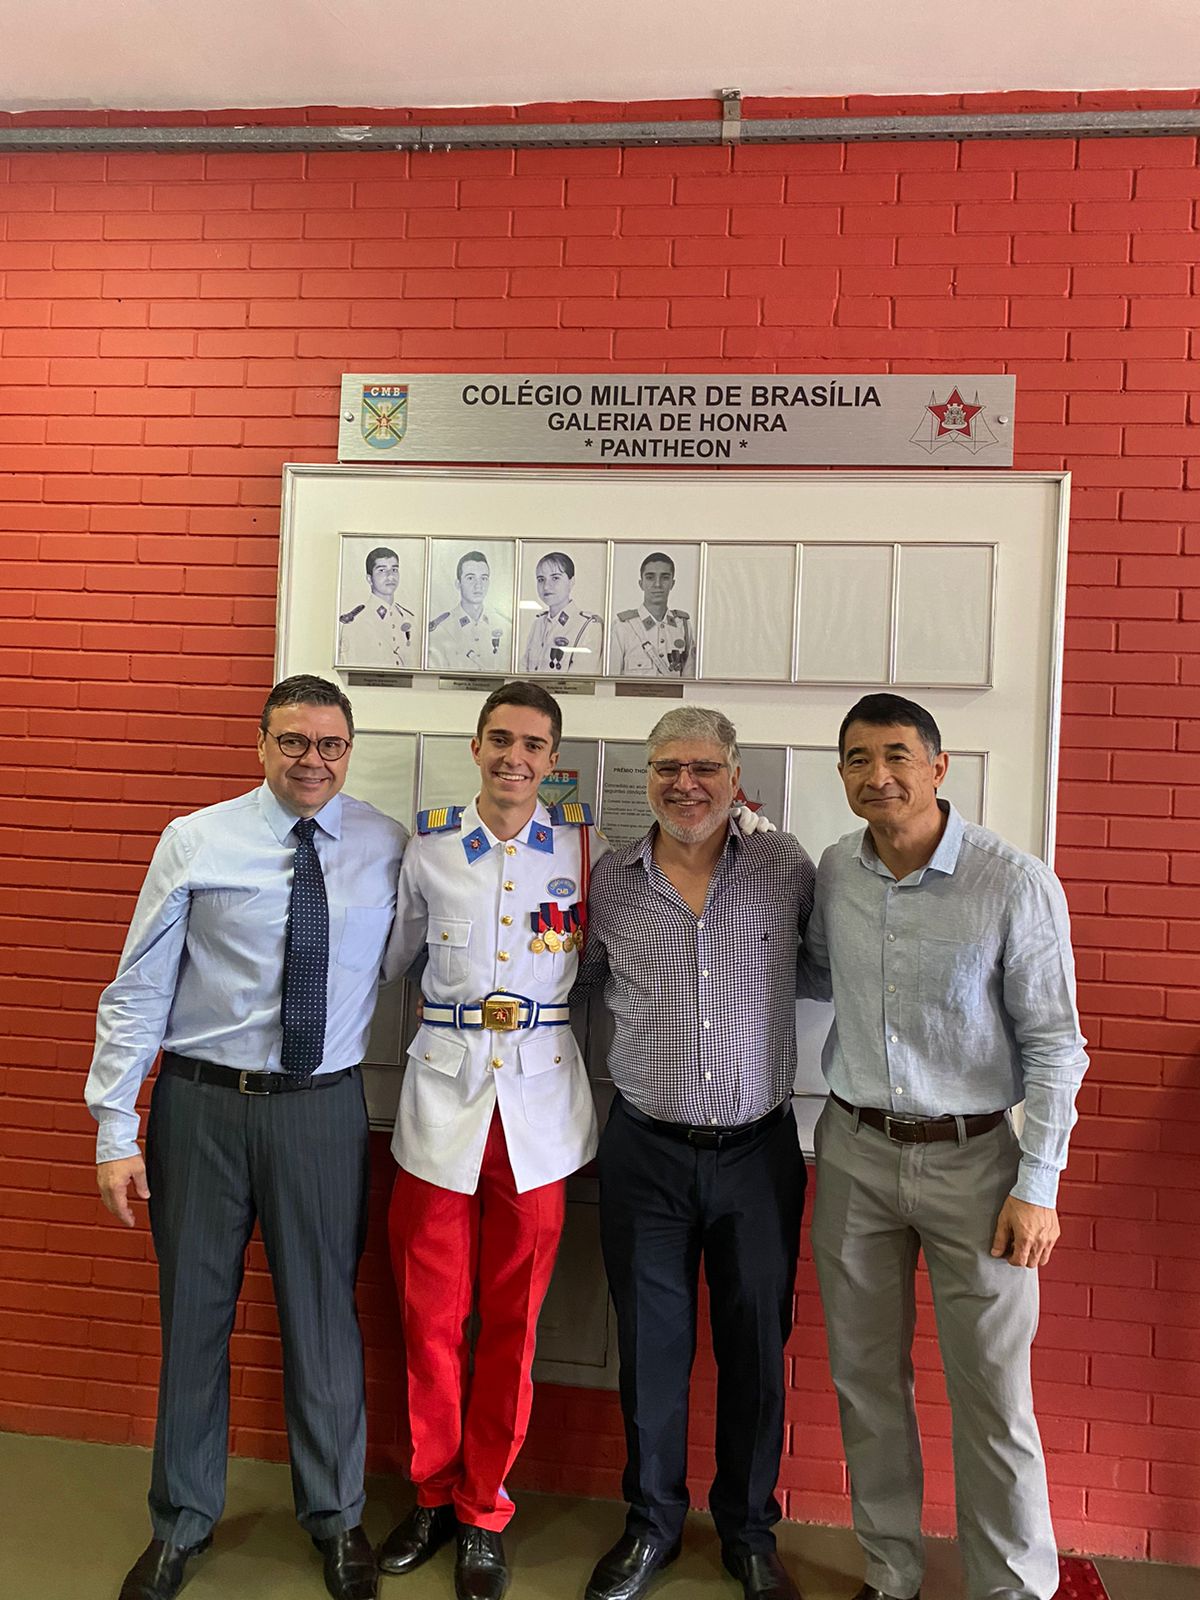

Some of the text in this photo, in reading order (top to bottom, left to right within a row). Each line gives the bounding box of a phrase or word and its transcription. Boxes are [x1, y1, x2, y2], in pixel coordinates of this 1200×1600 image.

[370, 387, 400, 397] CMB
[462, 380, 882, 407] COLÉGIO MILITAR DE BRASÍLIA
[548, 412, 788, 432] GALERIA DE HONRA
[600, 438, 731, 457] PANTHEON
